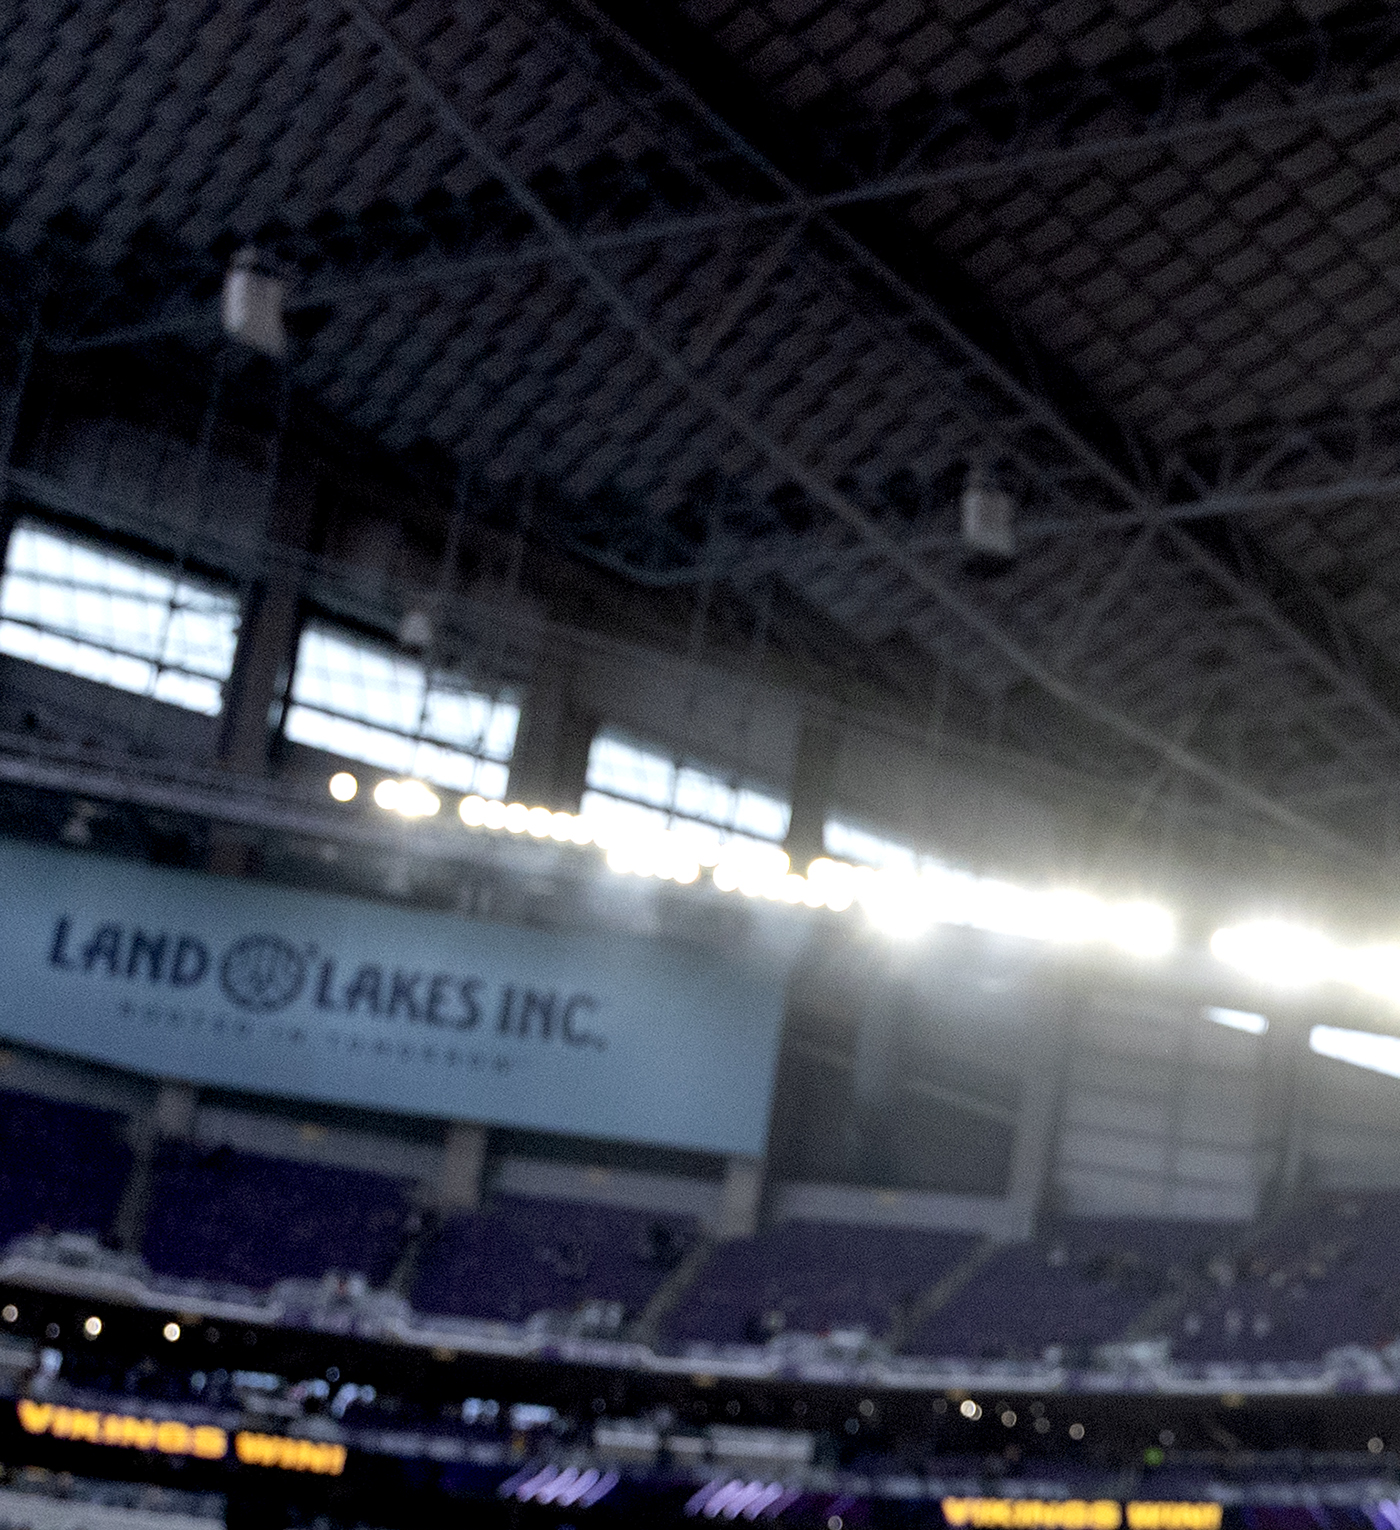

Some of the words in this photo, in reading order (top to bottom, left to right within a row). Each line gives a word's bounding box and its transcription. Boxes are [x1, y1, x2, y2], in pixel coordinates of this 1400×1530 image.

[48, 912, 211, 988] LAND
[495, 981, 607, 1053] INC.
[17, 1400, 228, 1460] VIKINGS
